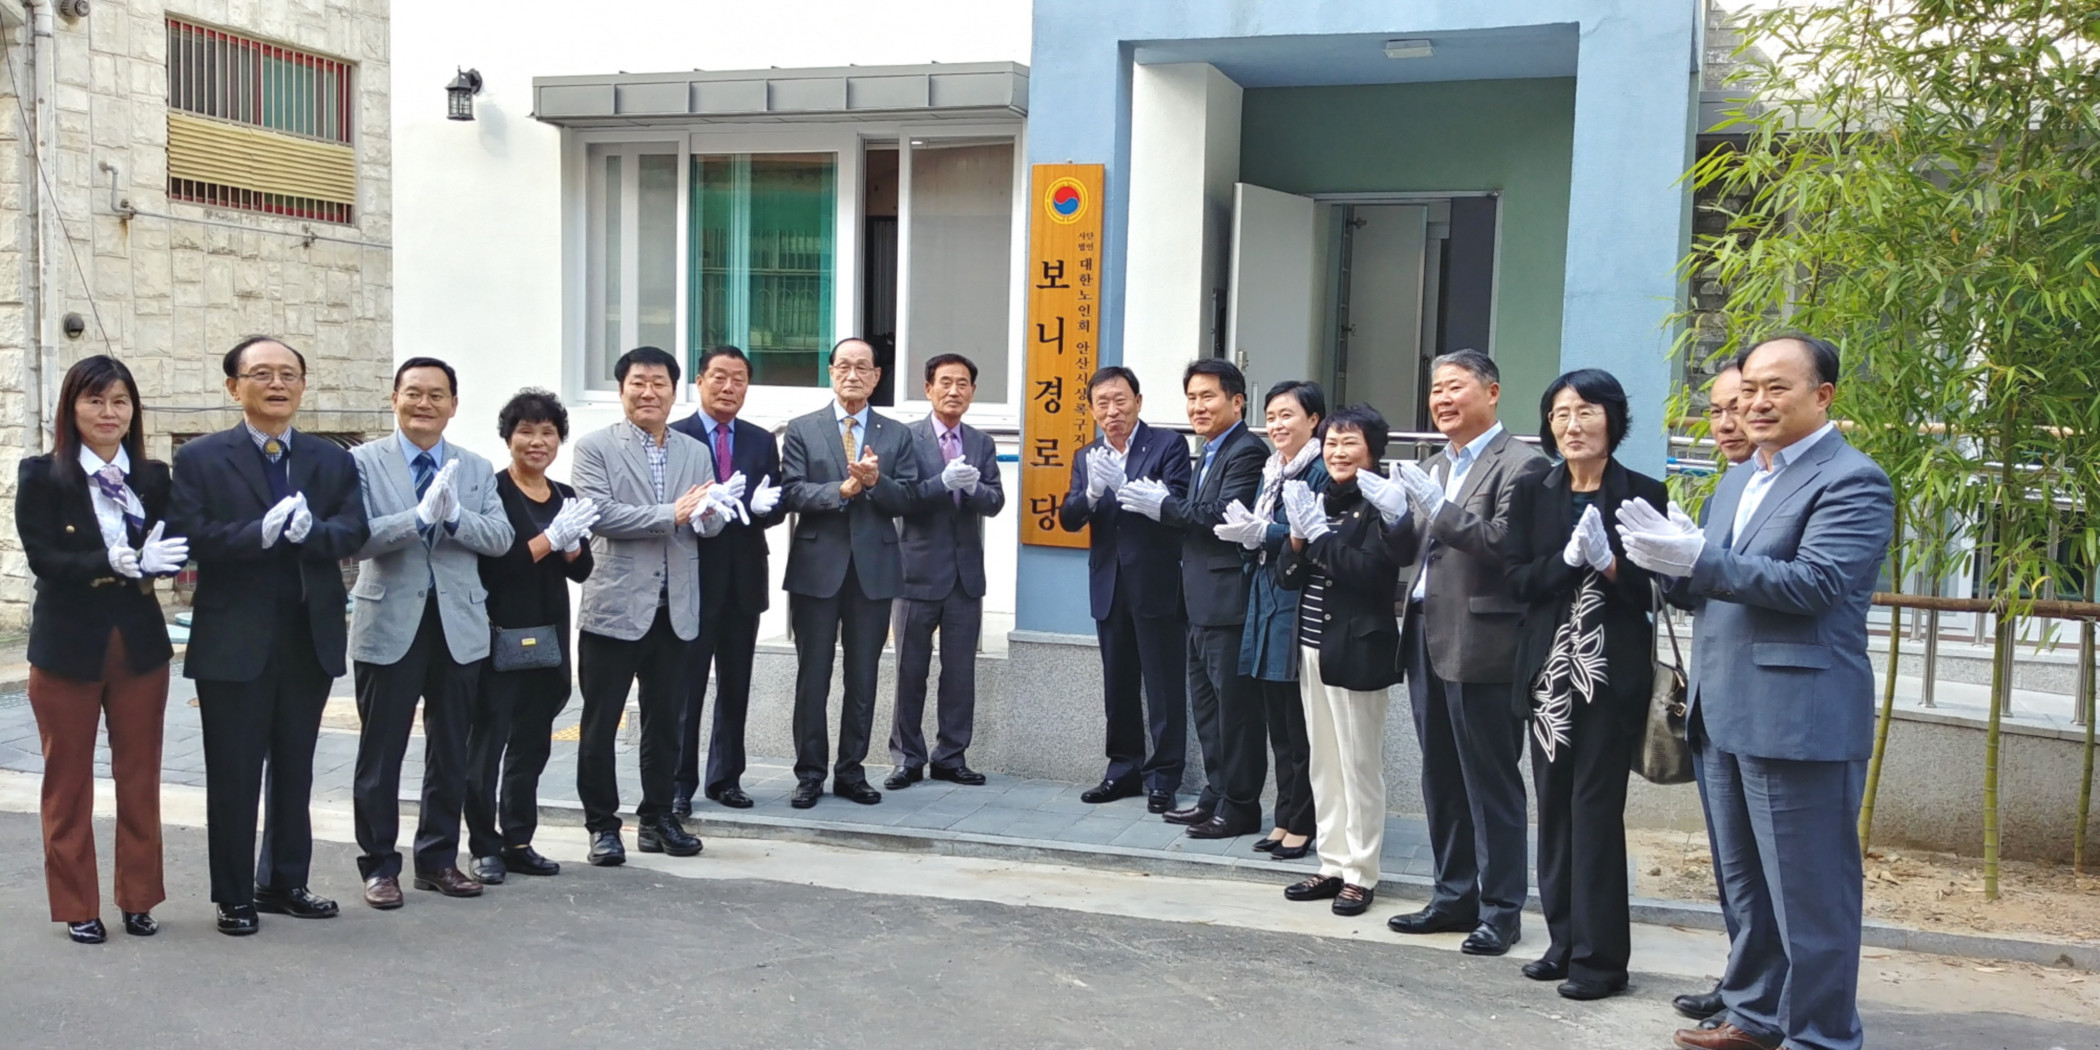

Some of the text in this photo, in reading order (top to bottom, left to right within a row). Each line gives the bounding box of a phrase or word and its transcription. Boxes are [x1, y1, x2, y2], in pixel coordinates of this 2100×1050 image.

[1078, 242, 1094, 251] 법인
[1079, 232, 1094, 241] 사단
[1078, 258, 1093, 333] 대한노인회
[1029, 260, 1070, 531] 보니경로당
